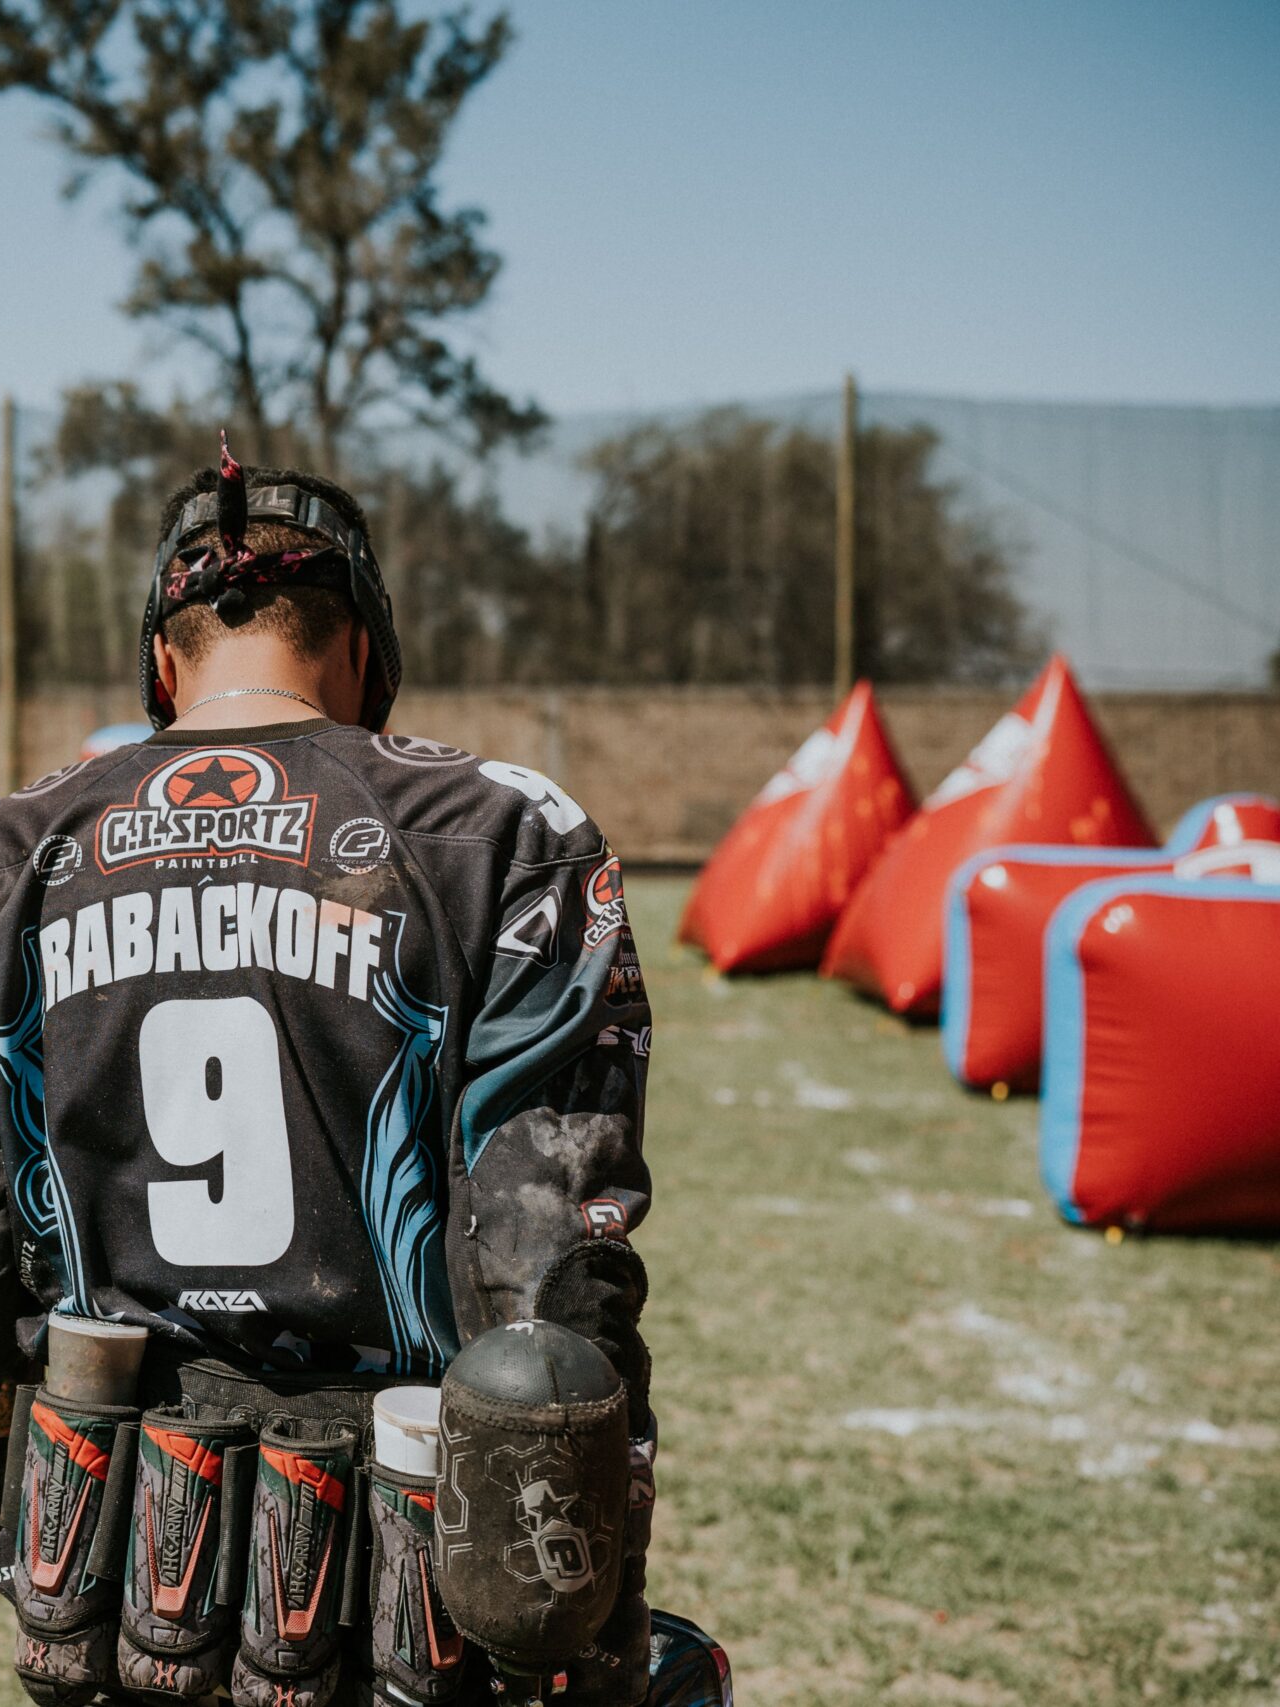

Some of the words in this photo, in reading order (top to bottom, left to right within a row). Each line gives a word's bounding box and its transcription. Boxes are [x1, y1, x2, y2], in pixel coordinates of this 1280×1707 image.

[155, 853, 259, 870] PAINTBALL
[39, 882, 383, 1013] RABACKOFF
[139, 996, 295, 1267] 9
[177, 1290, 270, 1312] RAZA
